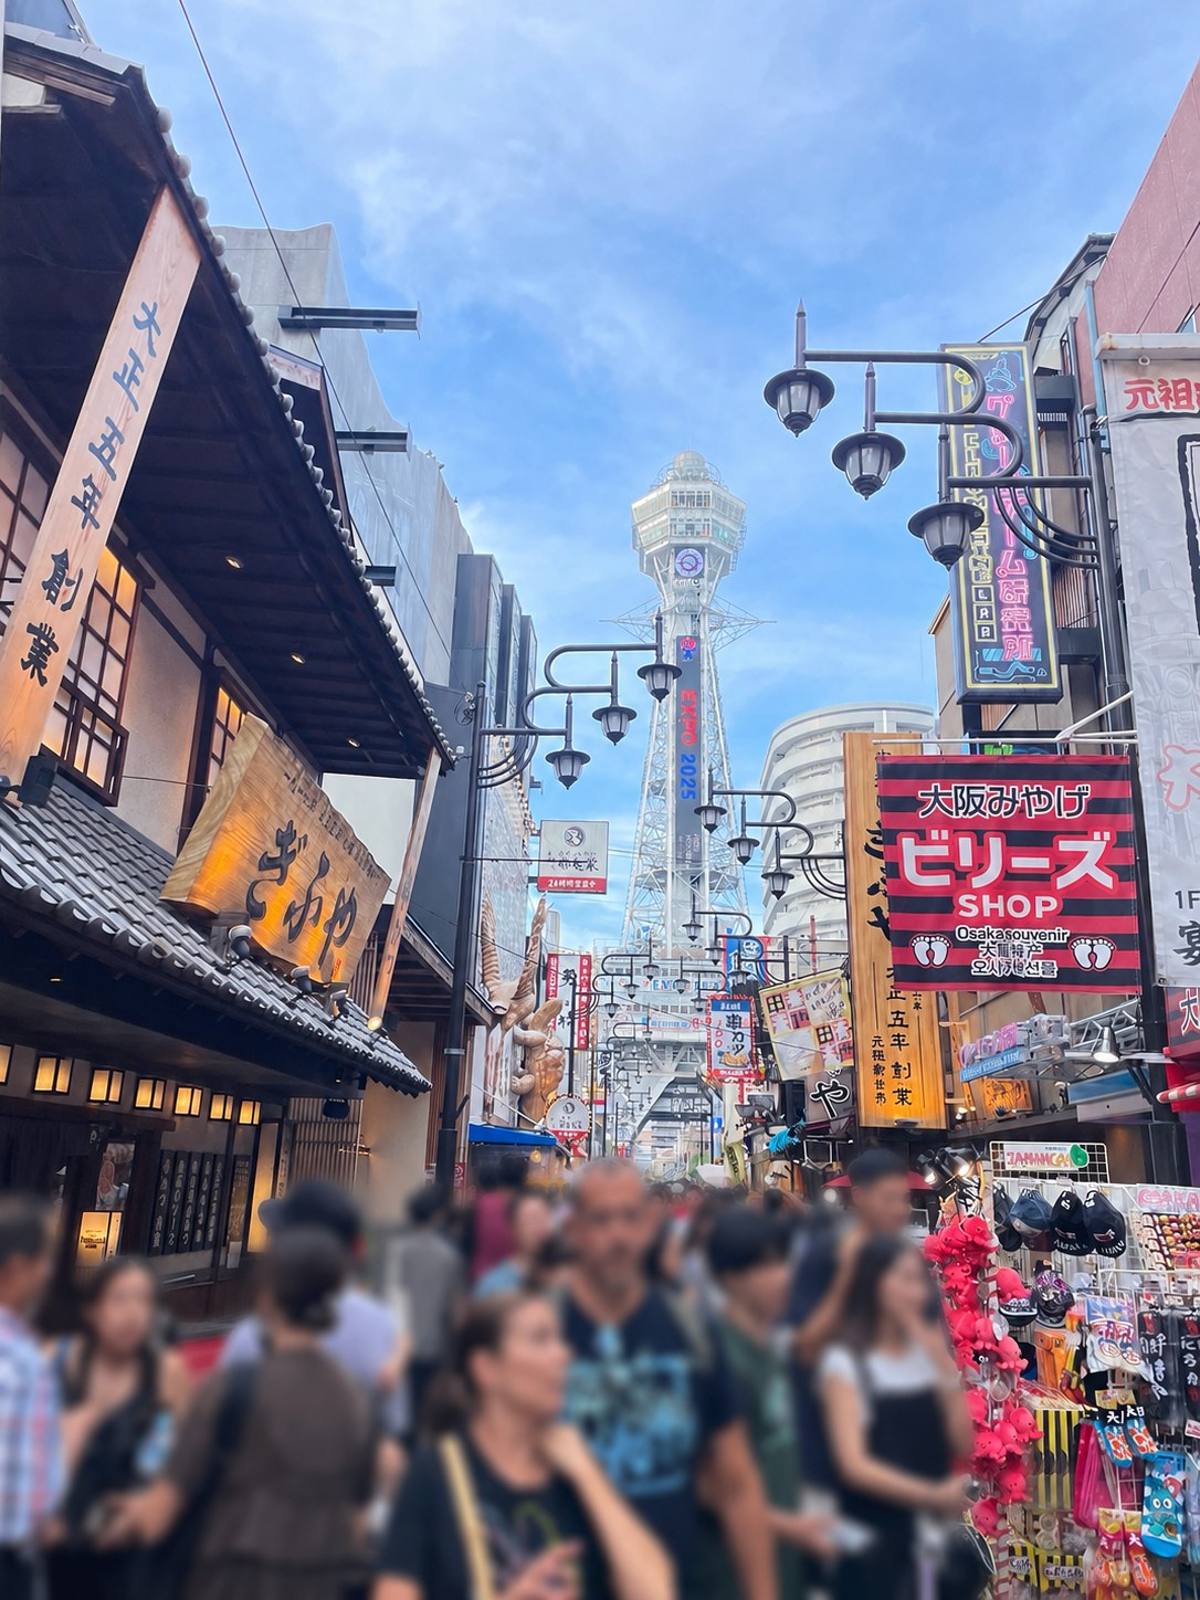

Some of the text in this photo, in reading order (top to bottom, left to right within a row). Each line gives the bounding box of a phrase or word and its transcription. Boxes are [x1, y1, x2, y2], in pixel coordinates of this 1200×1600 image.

[19, 301, 162, 687] 大正五年創業
[680, 688, 697, 747] EXPO
[681, 753, 697, 801] 2025
[919, 784, 1090, 818] 大阪みやげ
[900, 829, 1114, 890] ビリーズ
[958, 894, 1058, 918] SHOP
[886, 968, 912, 1106] 正五年創業
